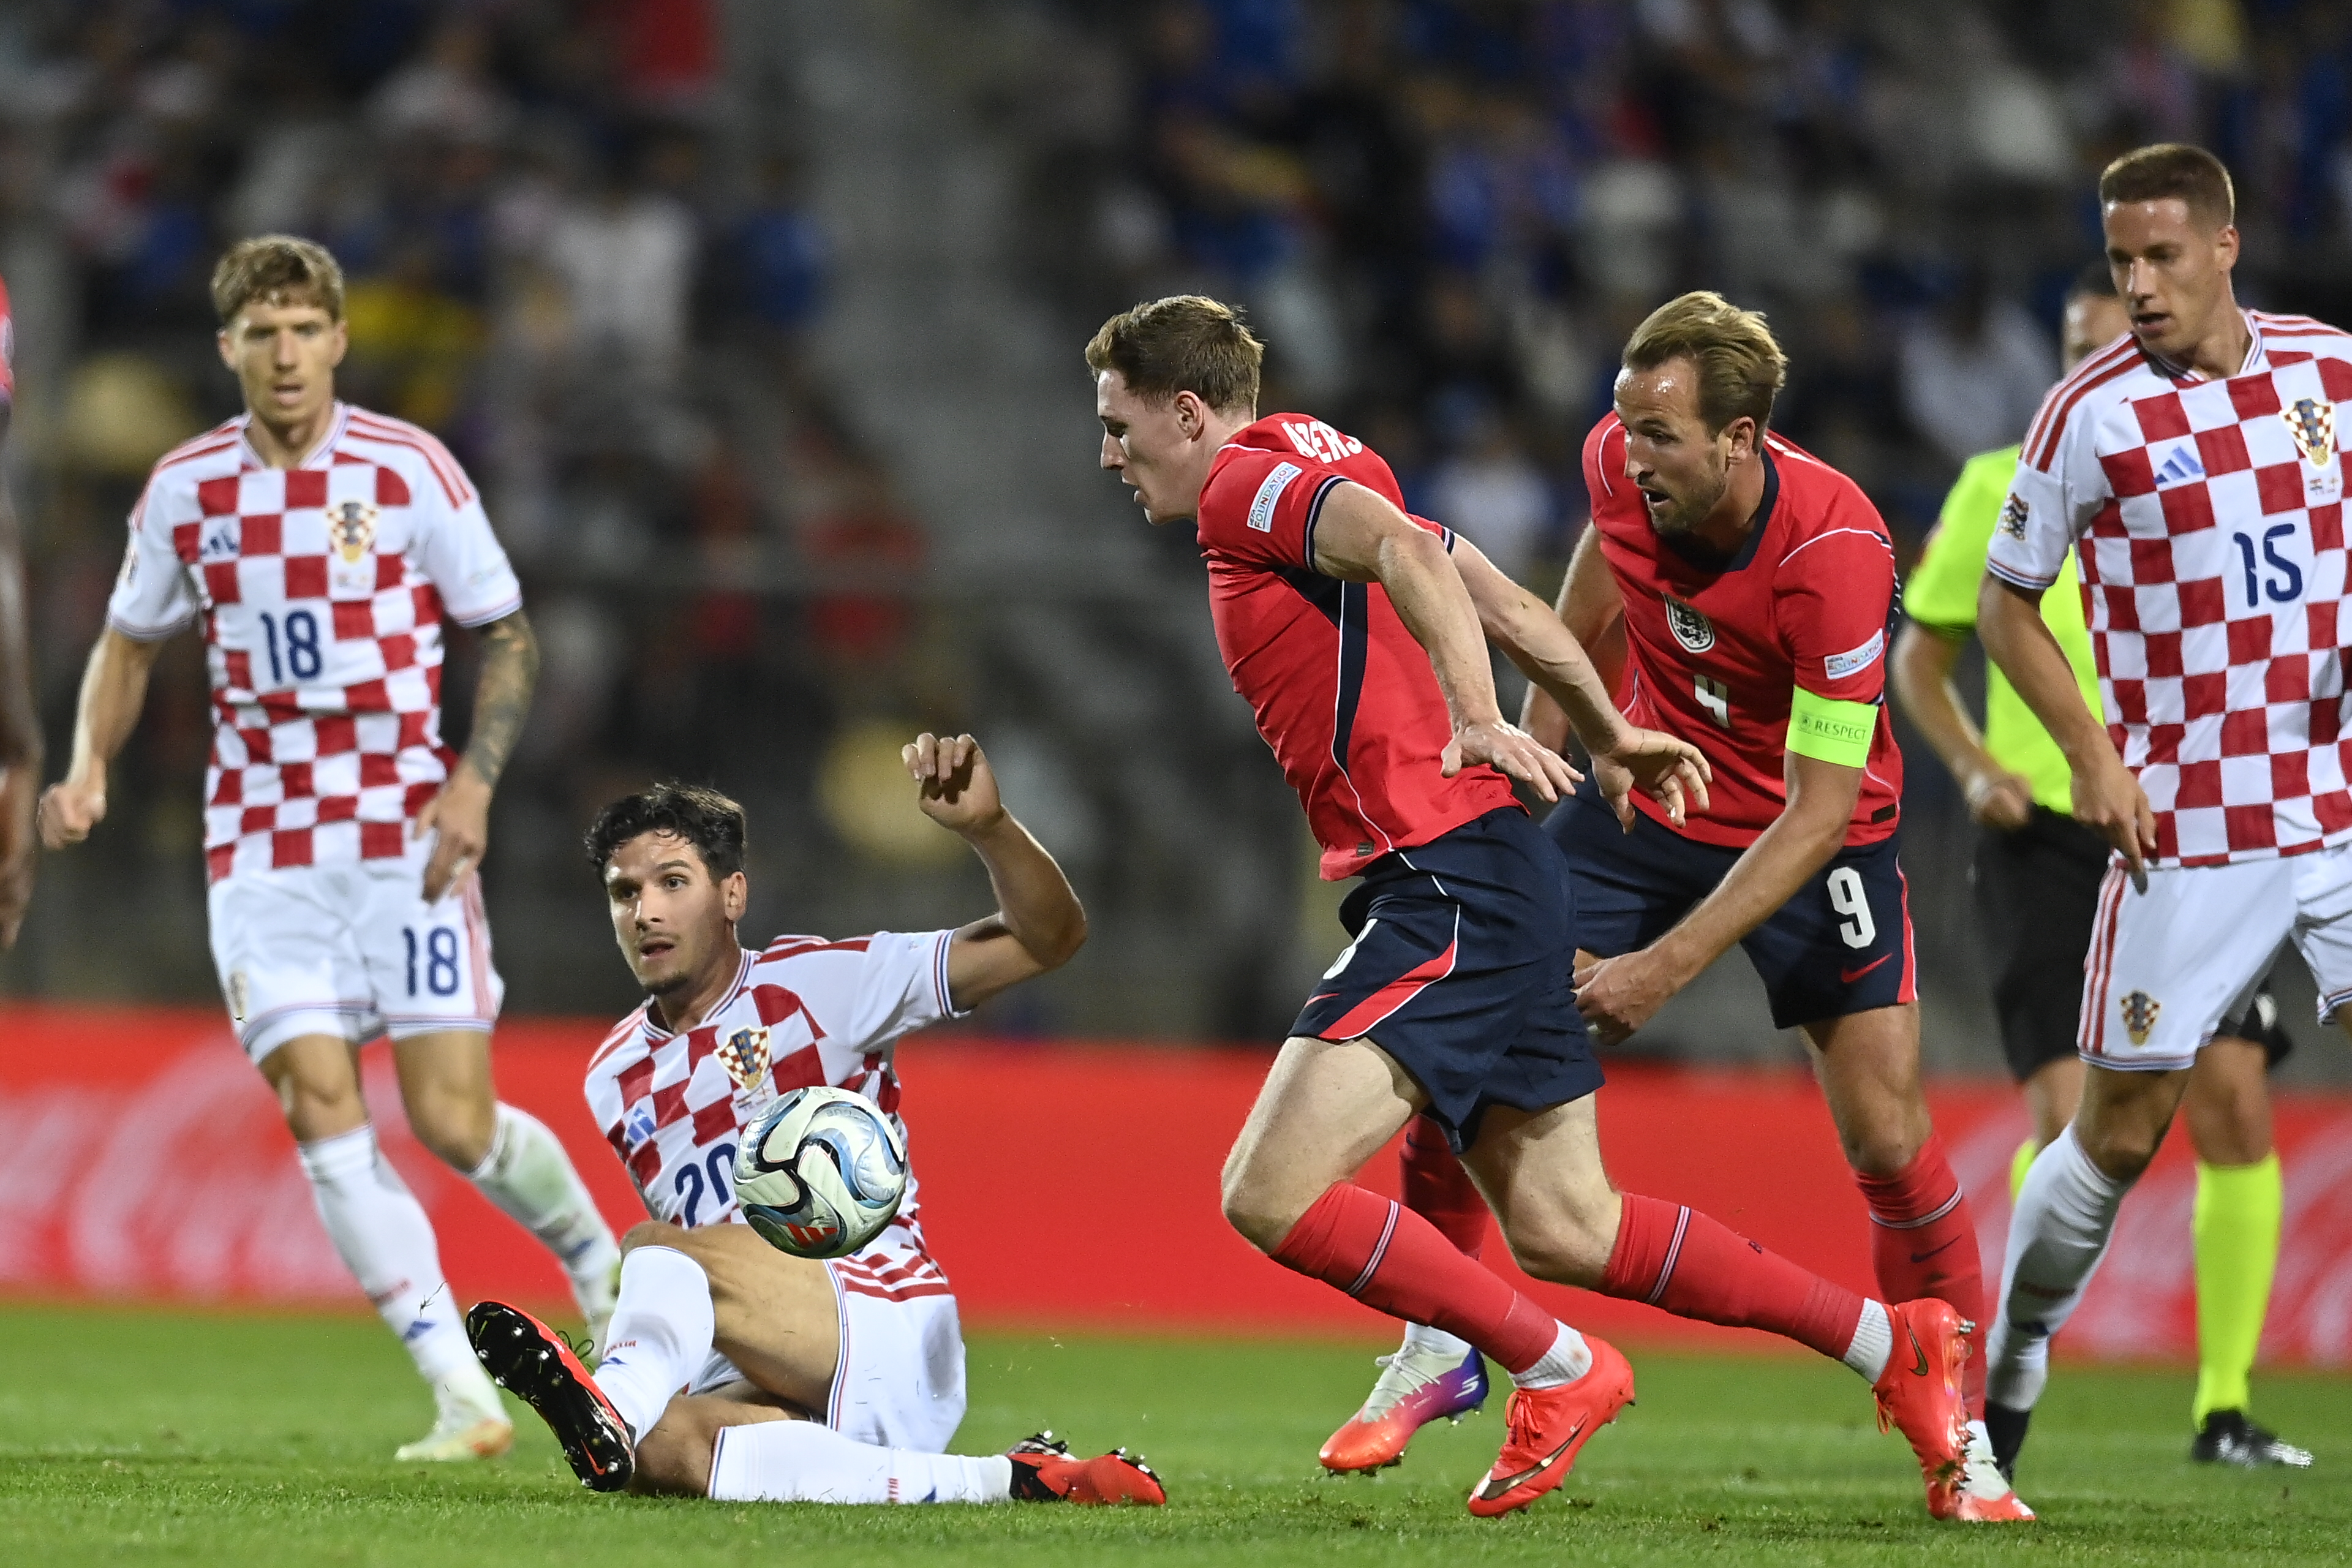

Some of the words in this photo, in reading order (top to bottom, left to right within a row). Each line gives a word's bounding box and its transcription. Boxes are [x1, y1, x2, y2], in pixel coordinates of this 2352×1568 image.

[2233, 522, 2303, 608] 15
[260, 611, 322, 682] 18
[1814, 720, 1867, 741] RESPECT
[1826, 866, 1876, 949] 9
[402, 926, 459, 998] 18
